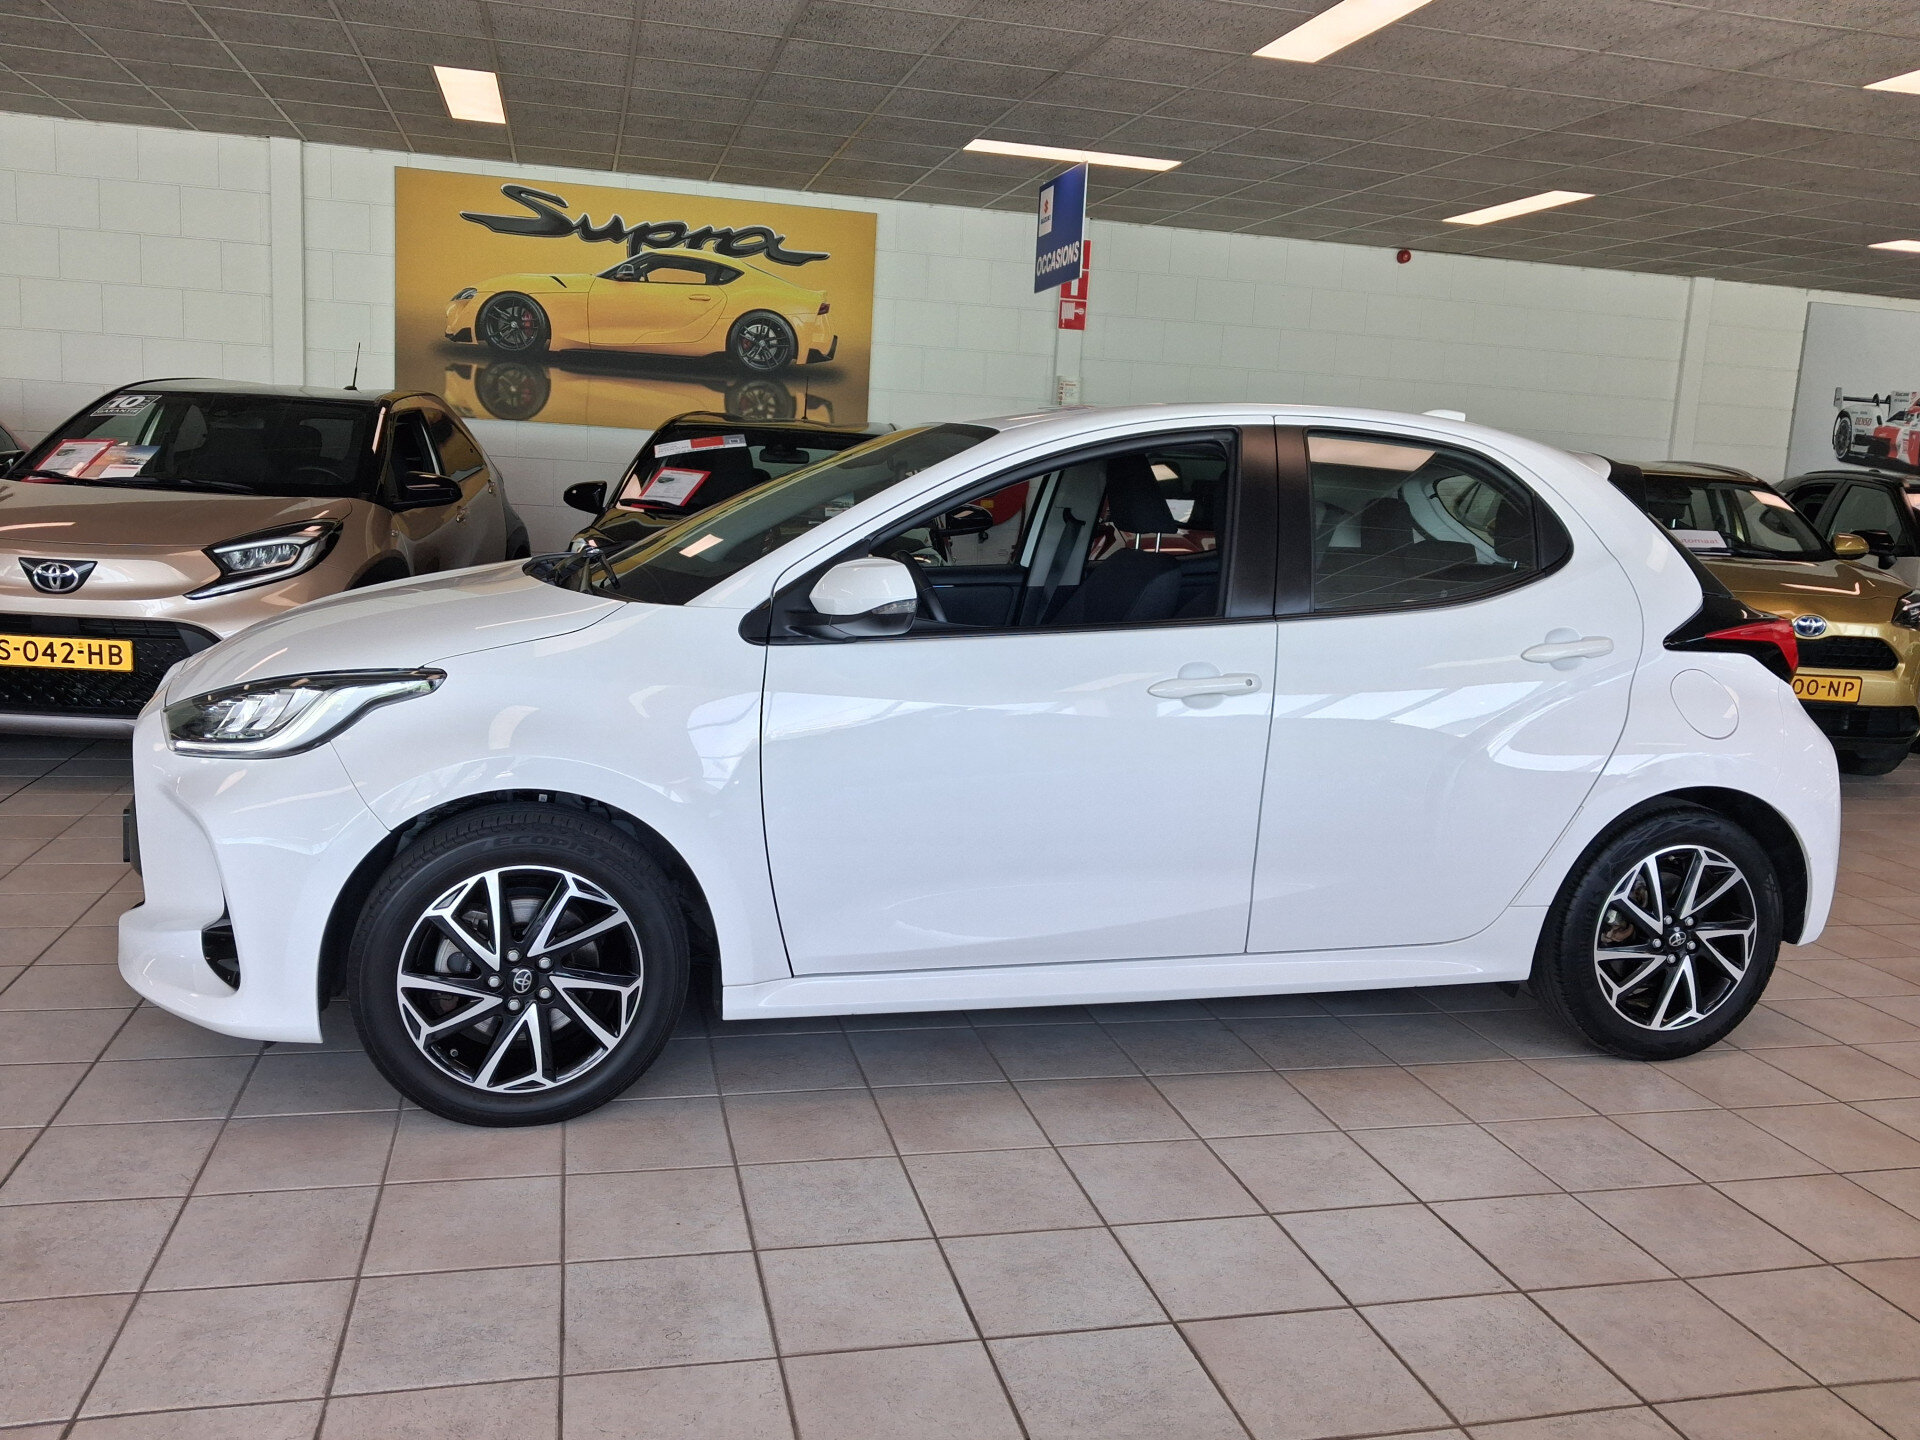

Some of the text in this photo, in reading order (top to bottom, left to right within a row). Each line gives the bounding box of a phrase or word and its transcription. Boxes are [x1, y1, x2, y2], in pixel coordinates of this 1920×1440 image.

[460, 184, 831, 267] Supra
[1036, 241, 1080, 277] OCCASIONS
[108, 395, 146, 409] 10
[0, 639, 123, 665] S-042-HB
